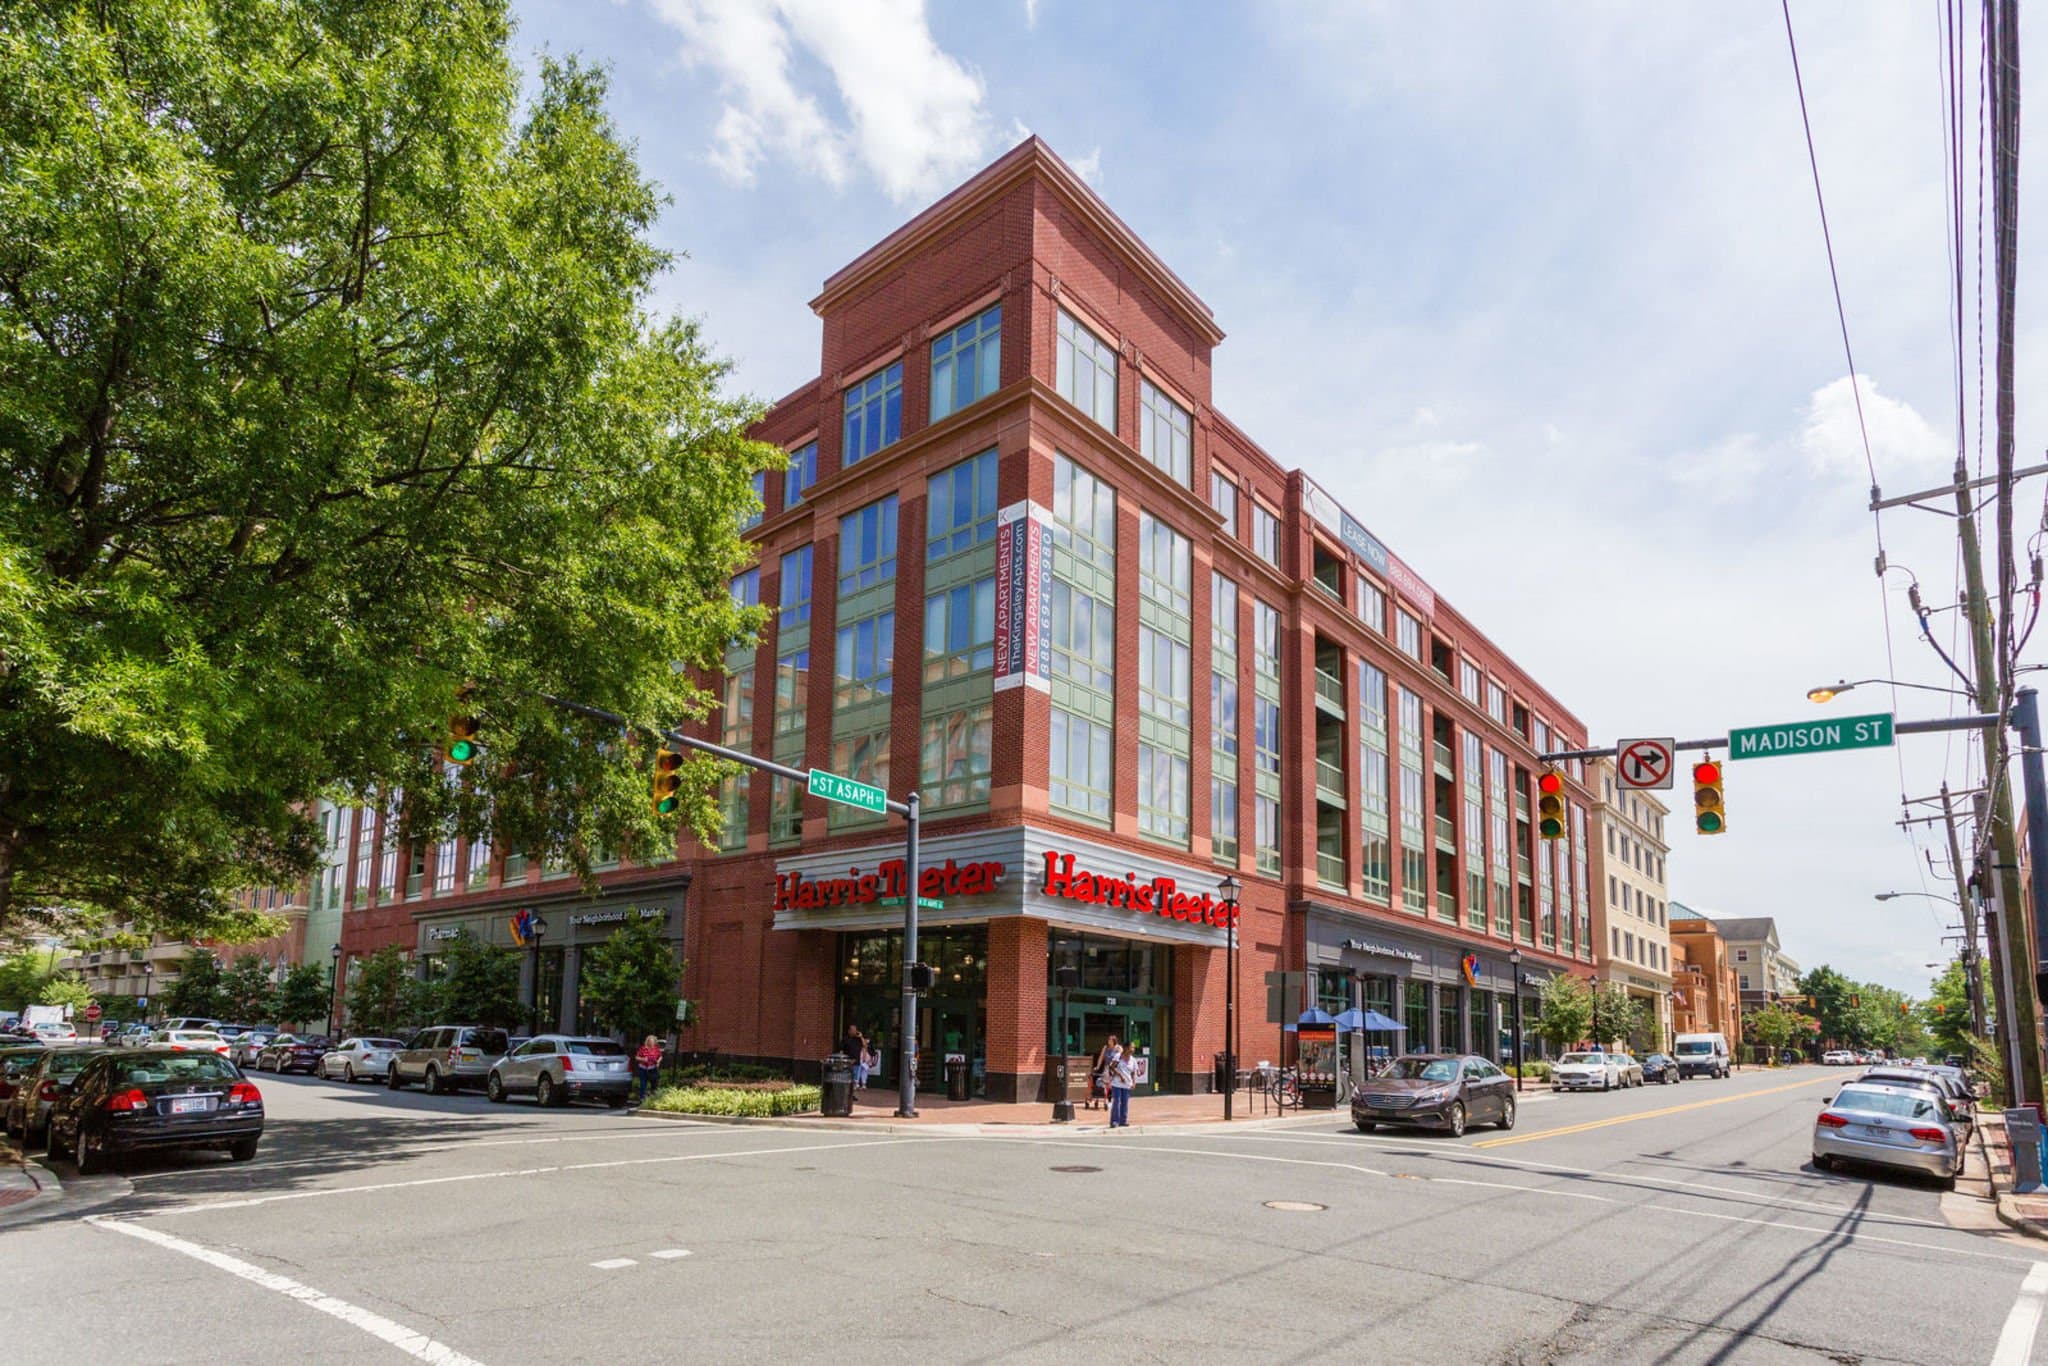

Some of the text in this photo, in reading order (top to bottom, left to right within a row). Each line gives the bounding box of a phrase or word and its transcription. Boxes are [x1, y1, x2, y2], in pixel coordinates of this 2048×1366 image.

[1343, 520, 1367, 551] LEASE
[997, 528, 1010, 672] NEW APARTMENTS
[1010, 523, 1024, 669] TheKingsleyApts.com
[1028, 526, 1040, 630] APARTMENTS
[1040, 533, 1052, 674] 888.694.0980
[1027, 631, 1037, 669] NEW
[1740, 720, 1884, 753] MADISON ST
[818, 776, 834, 793] ST
[836, 782, 875, 806] ASAPH
[772, 866, 880, 911] Harris
[1043, 850, 1154, 913] Harris
